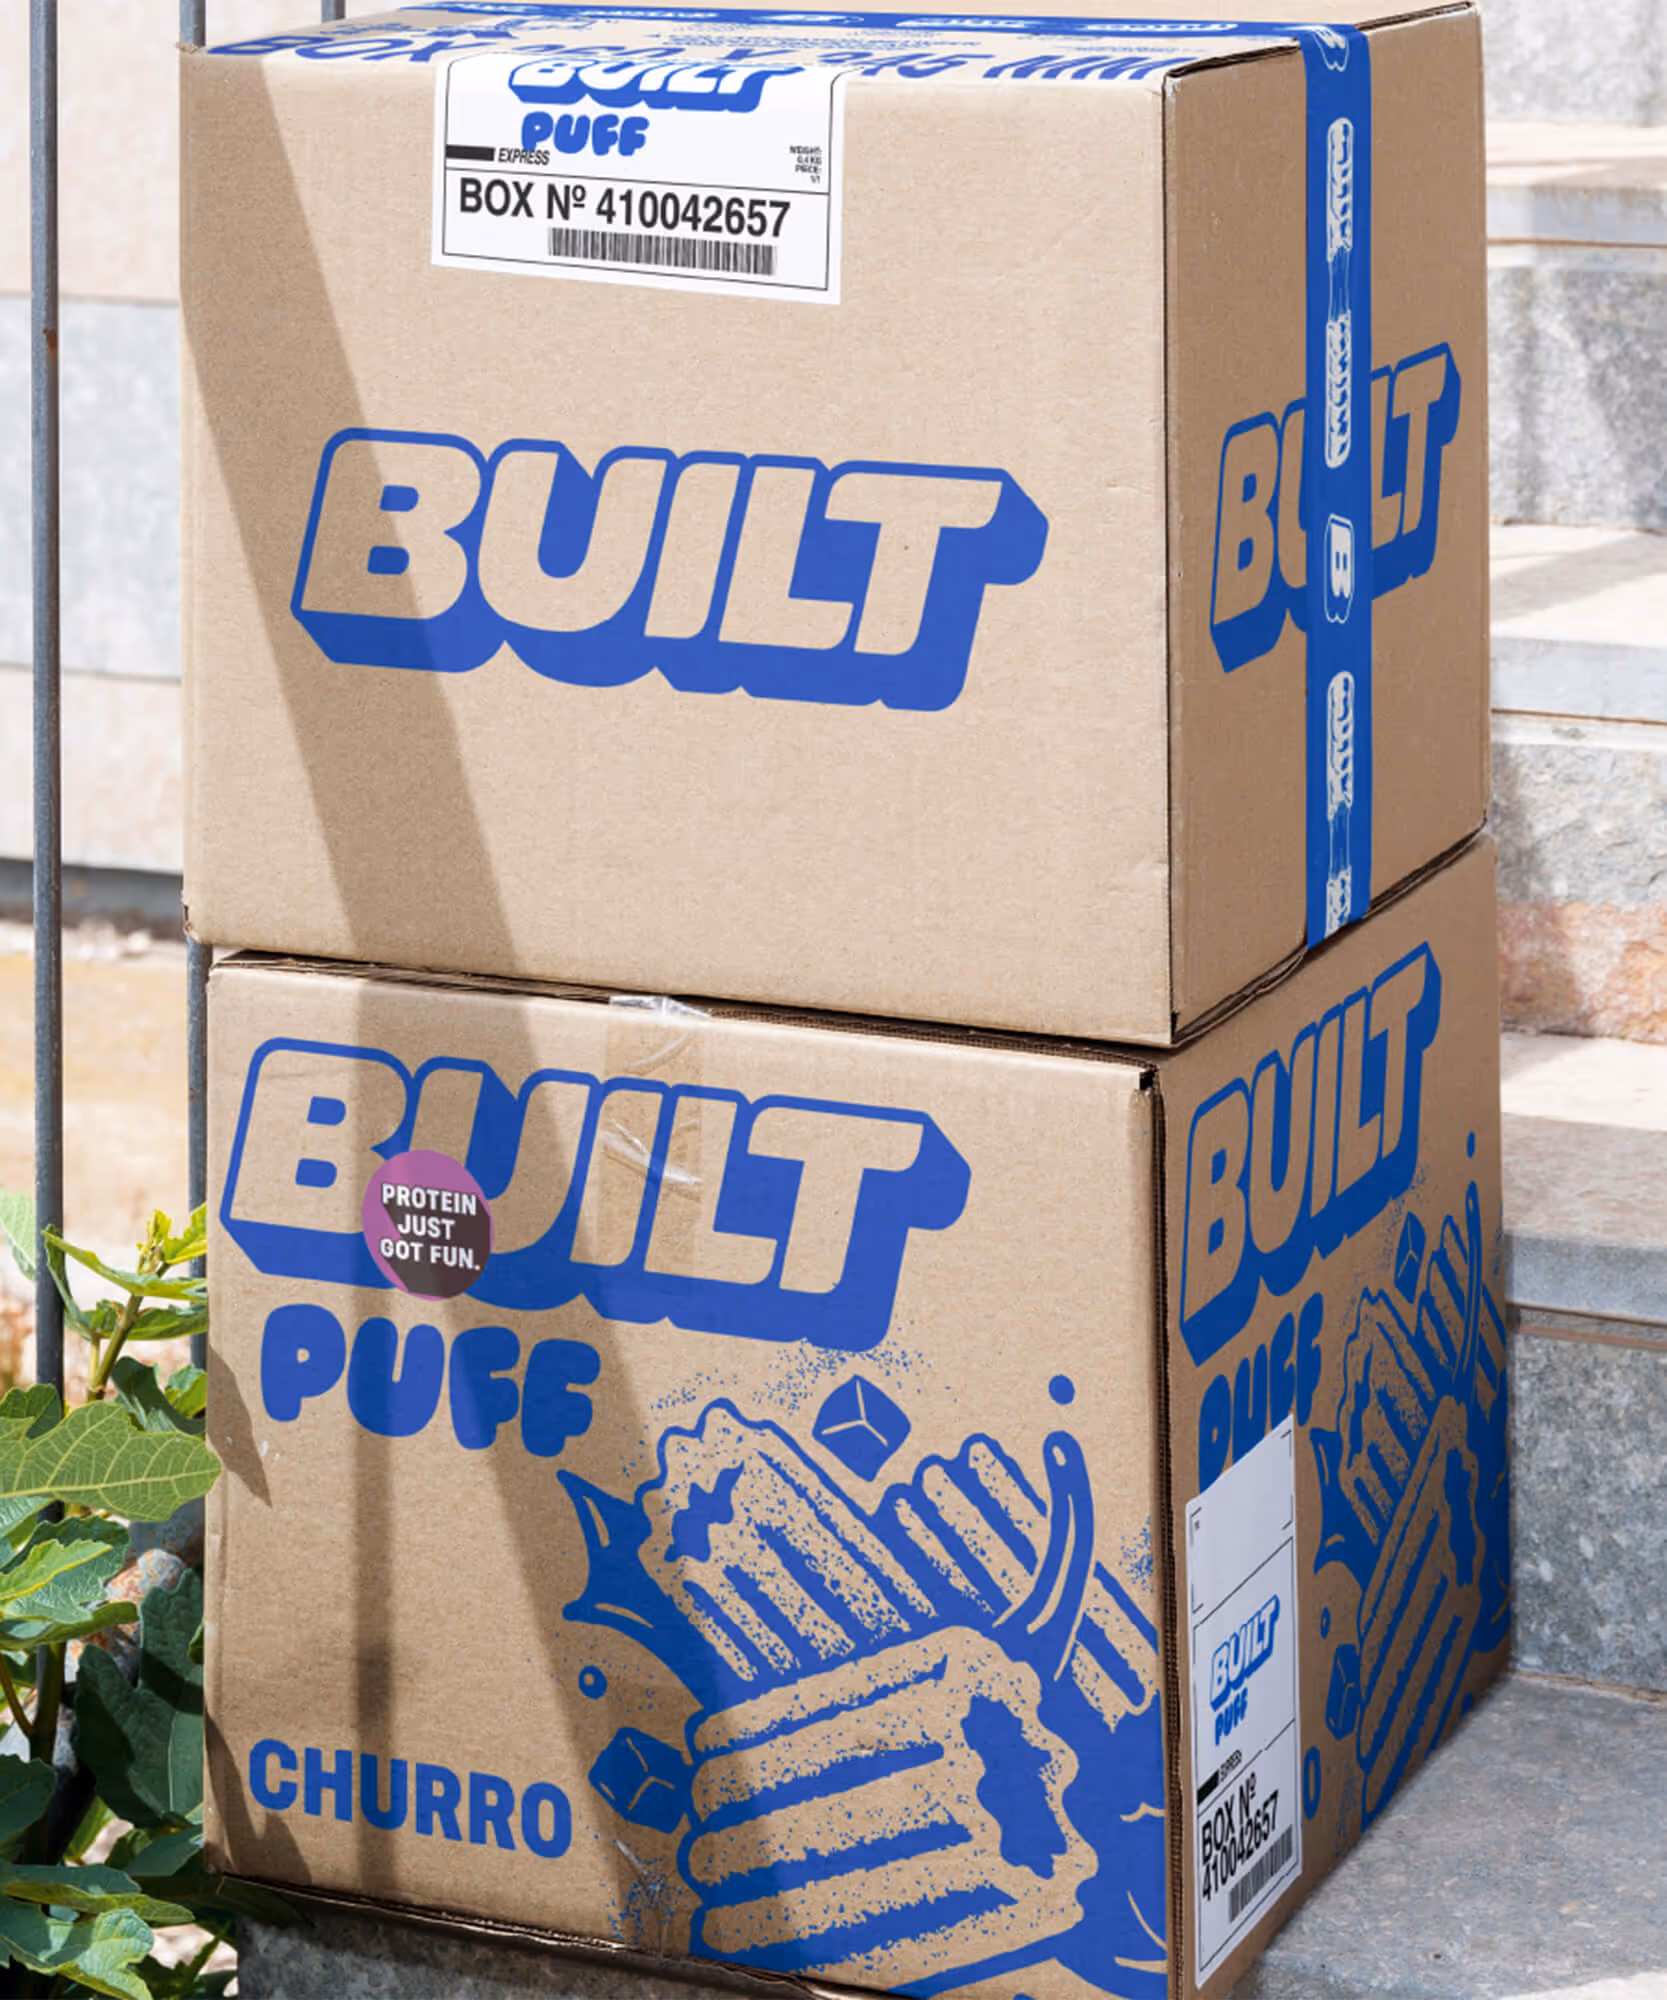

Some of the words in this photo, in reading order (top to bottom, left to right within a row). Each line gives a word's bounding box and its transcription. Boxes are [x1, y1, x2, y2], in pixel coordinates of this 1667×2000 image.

[207, 36, 490, 62] BOX
[984, 55, 1197, 80] MM
[508, 57, 806, 113] BUILT
[498, 148, 550, 166] EXPRESS
[521, 111, 650, 156] PUFF
[459, 177, 534, 218] BOX
[596, 188, 791, 237] 410042657
[1210, 342, 1461, 674] BLT
[291, 427, 1048, 712] BUILT
[1180, 941, 1441, 1367] BUILT
[220, 1037, 972, 1353] BUILT
[382, 1183, 477, 1216] PROTEIN
[397, 1213, 456, 1241] JUST
[380, 1238, 424, 1263] GOT
[430, 1245, 480, 1271] FUN.
[261, 1303, 600, 1457] PUFF
[1210, 1594, 1281, 1712] BUILT
[1215, 1687, 1249, 1747] PUFF
[249, 1739, 572, 1859] CHURRO
[1202, 1793, 1235, 1866] BOX
[1202, 1788, 1279, 1902] 410042657
